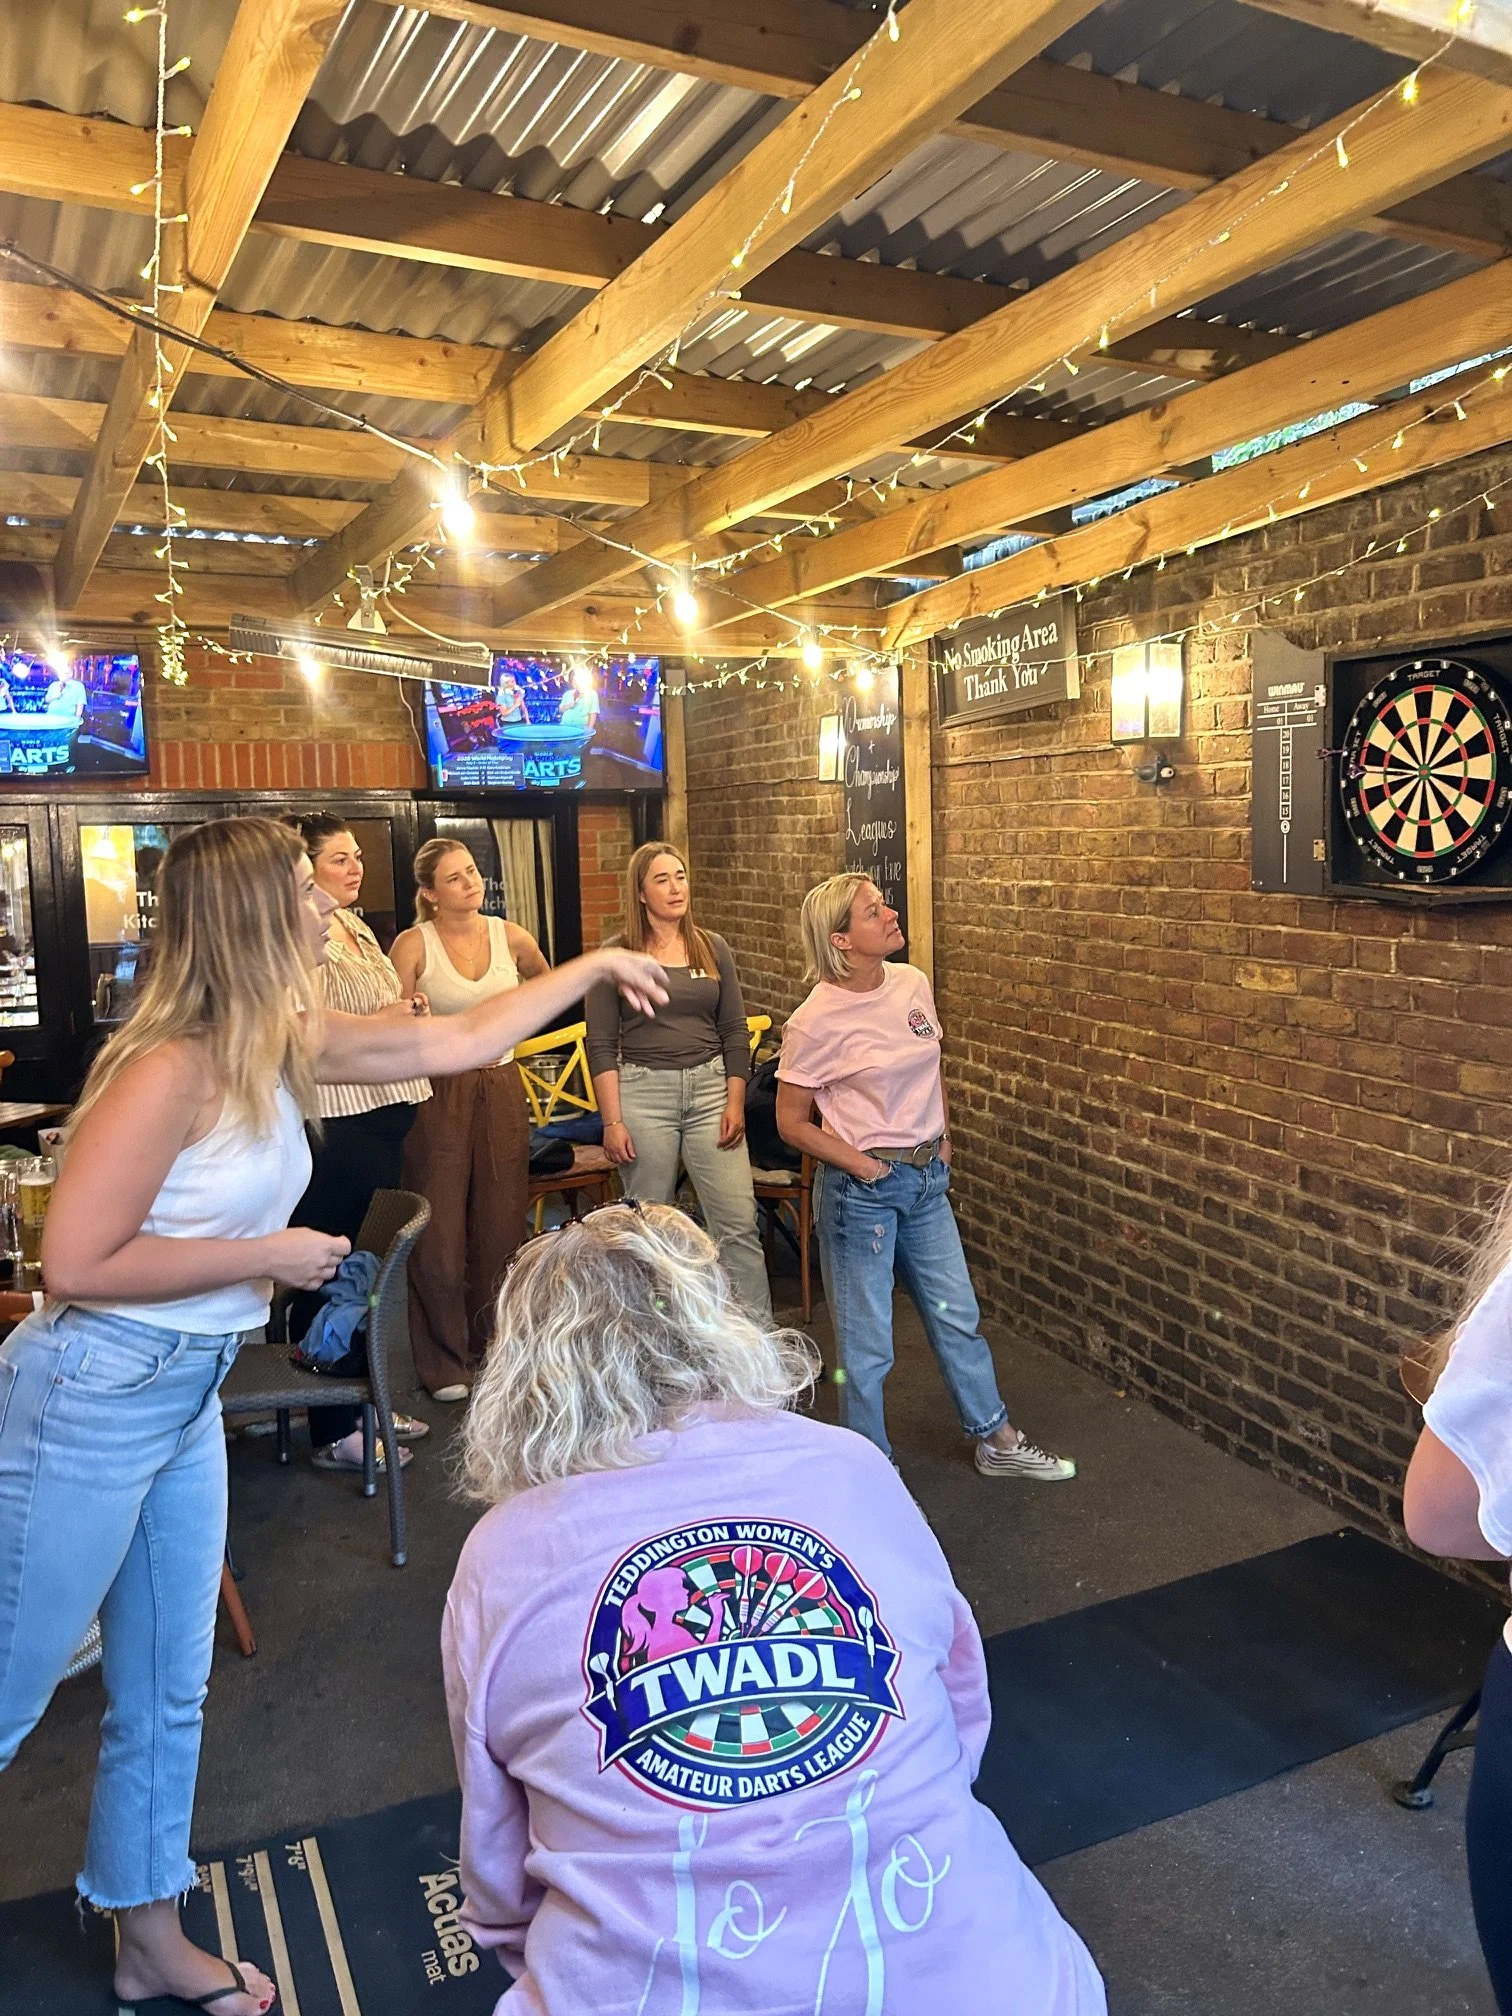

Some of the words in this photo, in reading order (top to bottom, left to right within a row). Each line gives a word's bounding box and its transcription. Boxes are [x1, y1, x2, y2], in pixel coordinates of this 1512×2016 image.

[944, 648, 962, 674] No
[963, 633, 1020, 665] Smoking
[1020, 622, 1058, 652] Area
[964, 667, 1008, 701] Thank
[1012, 665, 1038, 689] You
[1407, 670, 1441, 681] TARGET
[1263, 705, 1280, 714] Home
[1293, 702, 1310, 711] Away
[10, 745, 70, 764] ARTS
[524, 758, 582, 777] ARTS
[845, 797, 897, 857] Leagues
[136, 890, 159, 907] Th
[123, 913, 159, 930] Kitc
[604, 1525, 730, 1608] TEDDINGTON
[735, 1524, 837, 1569] WOMEN'S
[630, 1642, 857, 1718] TWADL
[636, 1748, 734, 1798] AMATEUR
[738, 1765, 806, 1798] DARTS
[804, 1710, 872, 1778] LEAGUE
[421, 1949, 446, 1985] mat
